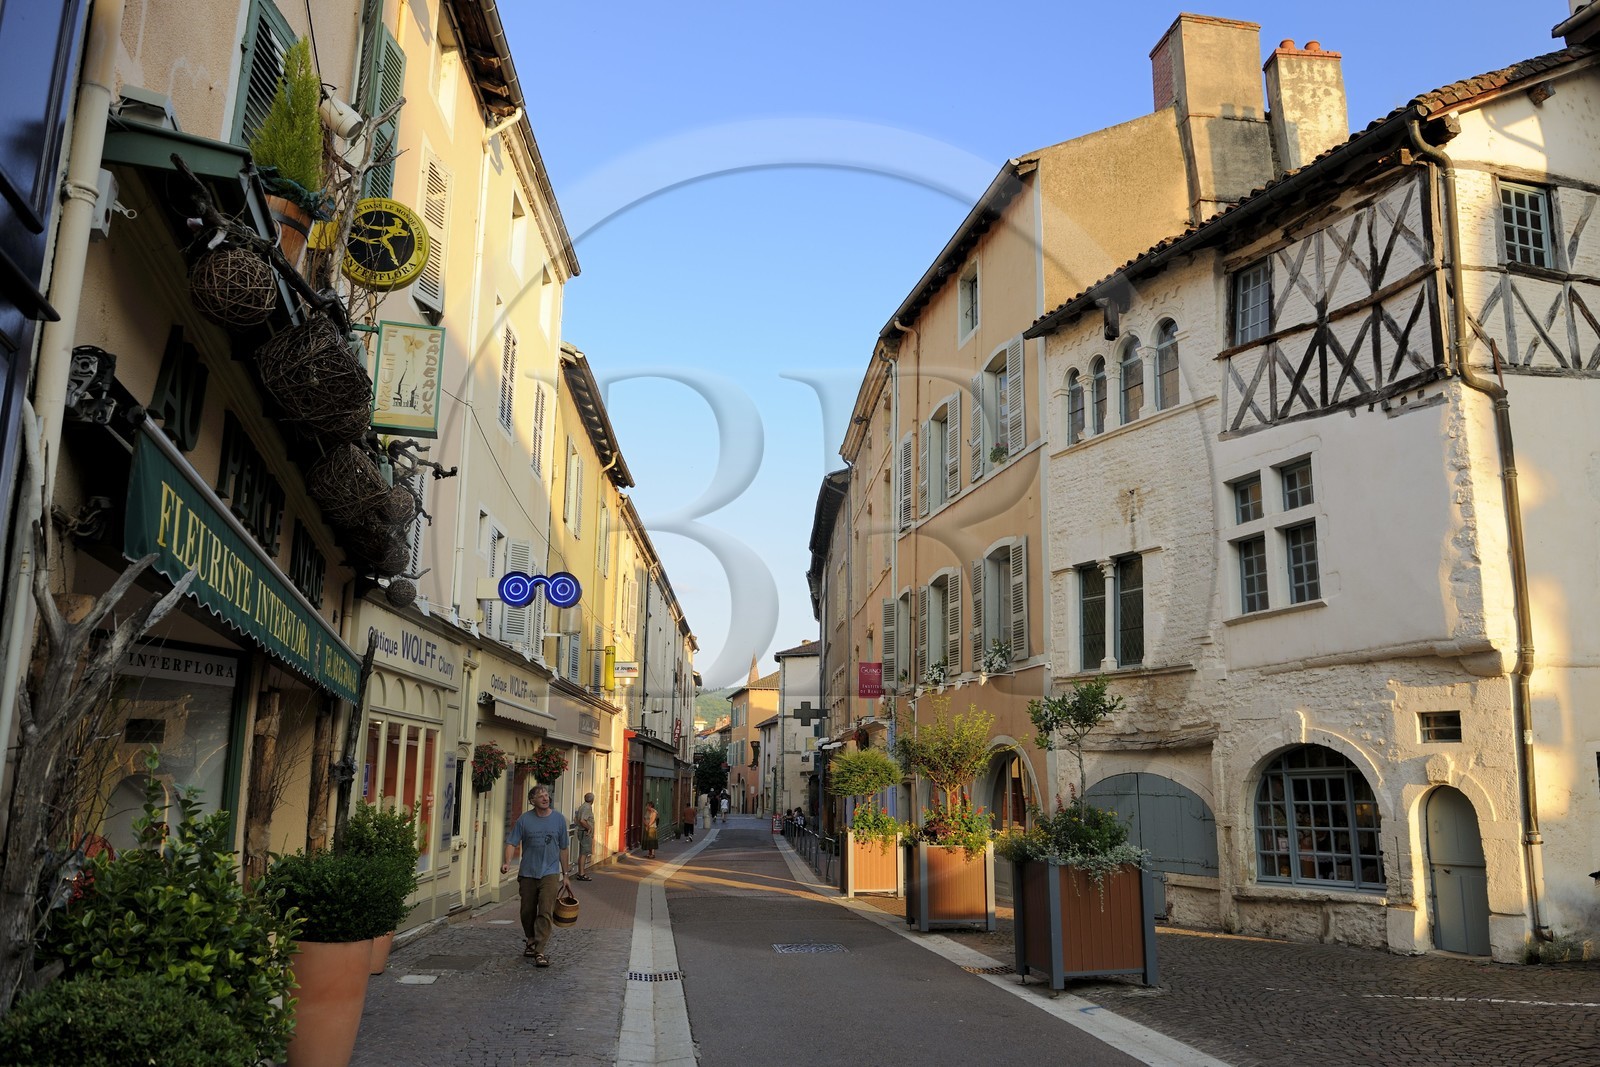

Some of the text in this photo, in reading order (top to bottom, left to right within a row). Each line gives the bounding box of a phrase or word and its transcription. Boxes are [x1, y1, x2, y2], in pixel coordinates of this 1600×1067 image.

[147, 325, 210, 452] AU
[379, 330, 399, 411] FLEURS
[421, 334, 441, 414] CADEAUX
[157, 481, 311, 663] FLEURISTE INTERFLORA
[128, 652, 234, 678] INTERFLORA
[401, 630, 437, 669] WOLFF
[438, 655, 455, 680] Cluny
[491, 674, 507, 694] Optique
[509, 674, 528, 700] WOLFF
